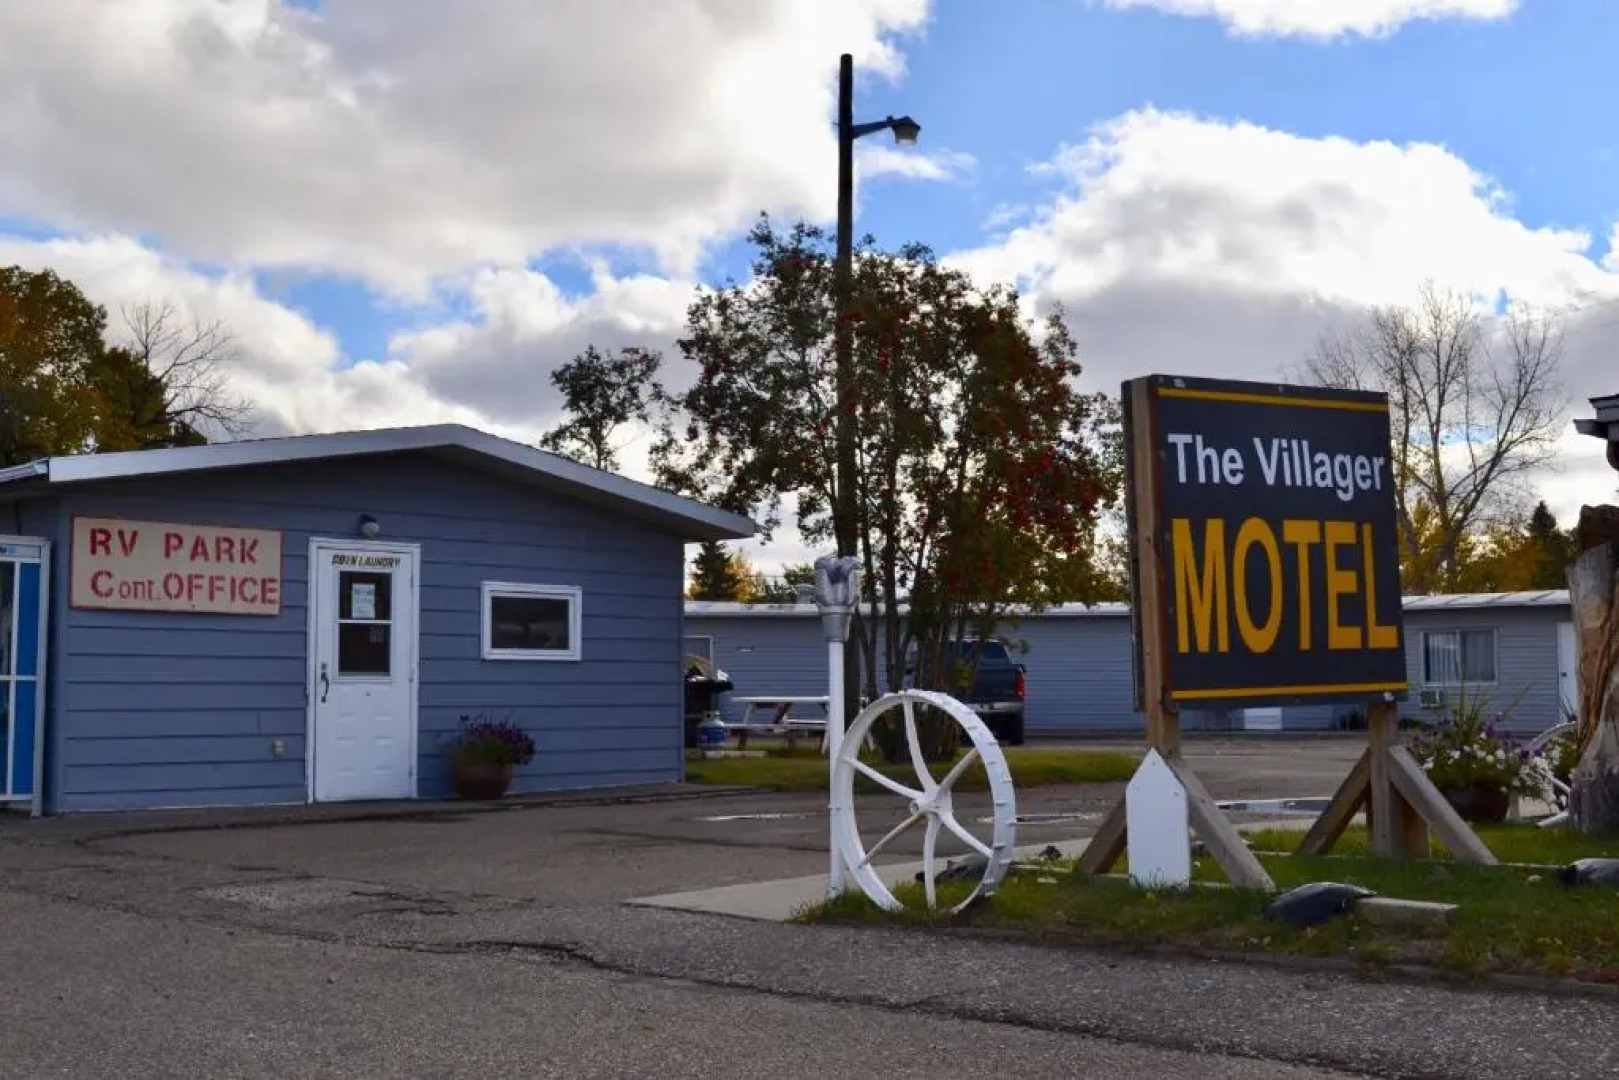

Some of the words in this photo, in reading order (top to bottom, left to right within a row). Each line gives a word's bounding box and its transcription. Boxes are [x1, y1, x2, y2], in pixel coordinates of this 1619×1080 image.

[1167, 433, 1244, 485] The
[1252, 437, 1385, 502] Villager
[89, 527, 139, 557] RV
[164, 532, 259, 564] PARK
[359, 556, 401, 568] LAUNDRY
[163, 572, 279, 605] OFFICE
[1172, 516, 1399, 654] MOTEL
